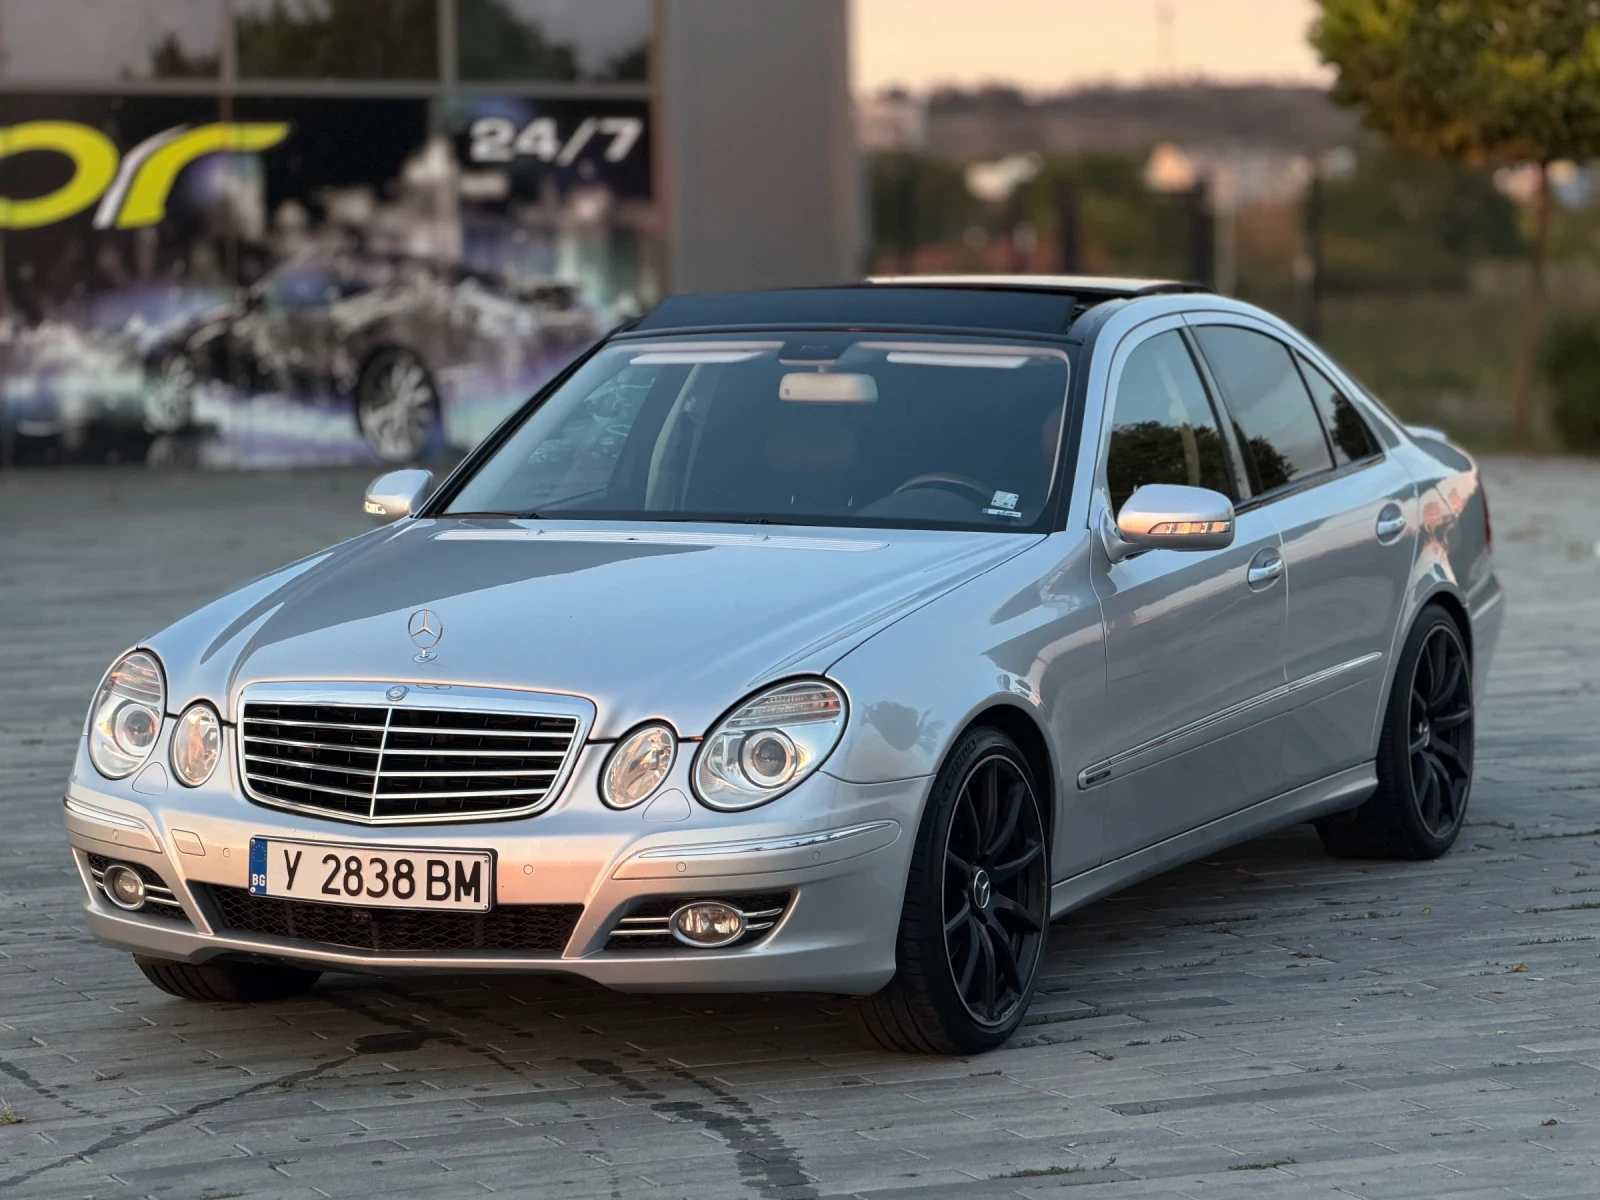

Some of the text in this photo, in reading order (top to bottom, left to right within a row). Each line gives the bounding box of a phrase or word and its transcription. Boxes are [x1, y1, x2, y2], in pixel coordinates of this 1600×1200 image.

[469, 117, 644, 167] 24/7
[252, 873, 266, 887] BG
[283, 849, 482, 903] Y 2838 BM
